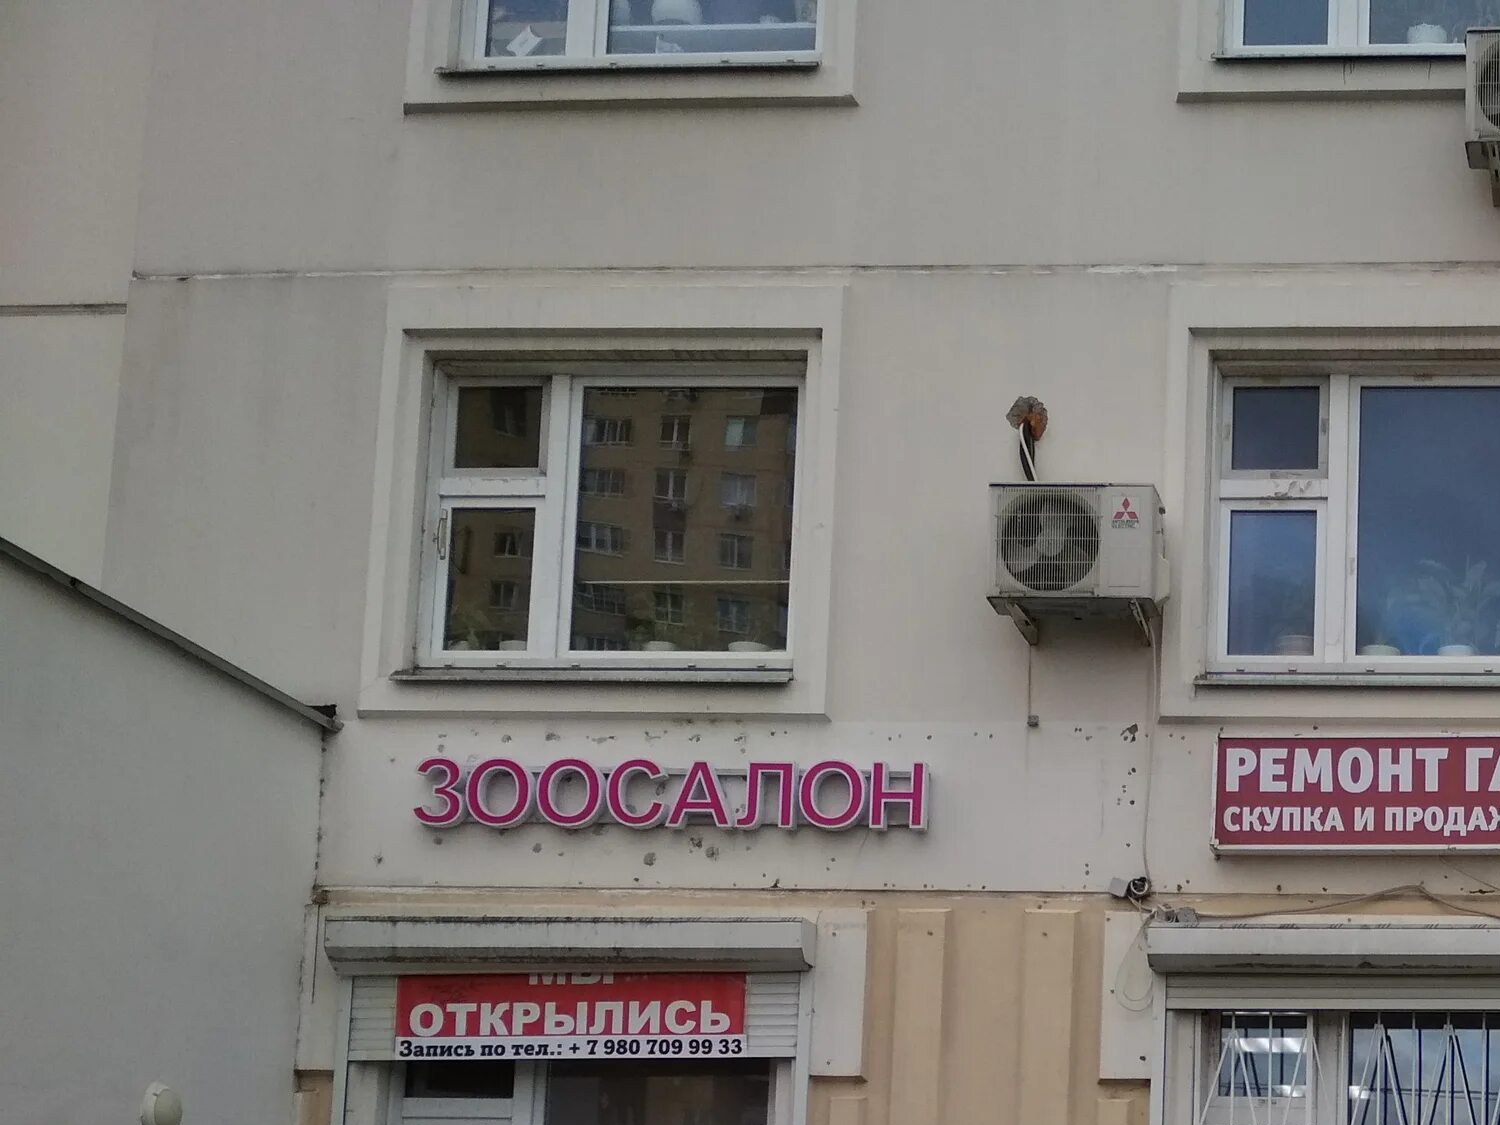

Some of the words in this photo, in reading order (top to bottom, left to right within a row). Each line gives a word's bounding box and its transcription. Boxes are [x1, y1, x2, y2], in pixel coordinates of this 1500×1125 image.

[1224, 747, 1448, 793] РЕМОНТ
[413, 756, 929, 831] ЗООСАЛОН
[1223, 805, 1345, 833] СКУПКА
[1353, 807, 1375, 831] И
[409, 1000, 731, 1038] ОТКРЫЛИСЬ
[399, 1040, 475, 1058] Запись
[480, 1044, 506, 1057] по
[511, 1043, 563, 1057] тел.:
[569, 1043, 580, 1055] +
[587, 1040, 599, 1055] 7
[604, 1040, 641, 1055] 980
[646, 1040, 683, 1055] 709
[688, 1039, 713, 1055] 99
[718, 1038, 743, 1055] 33
